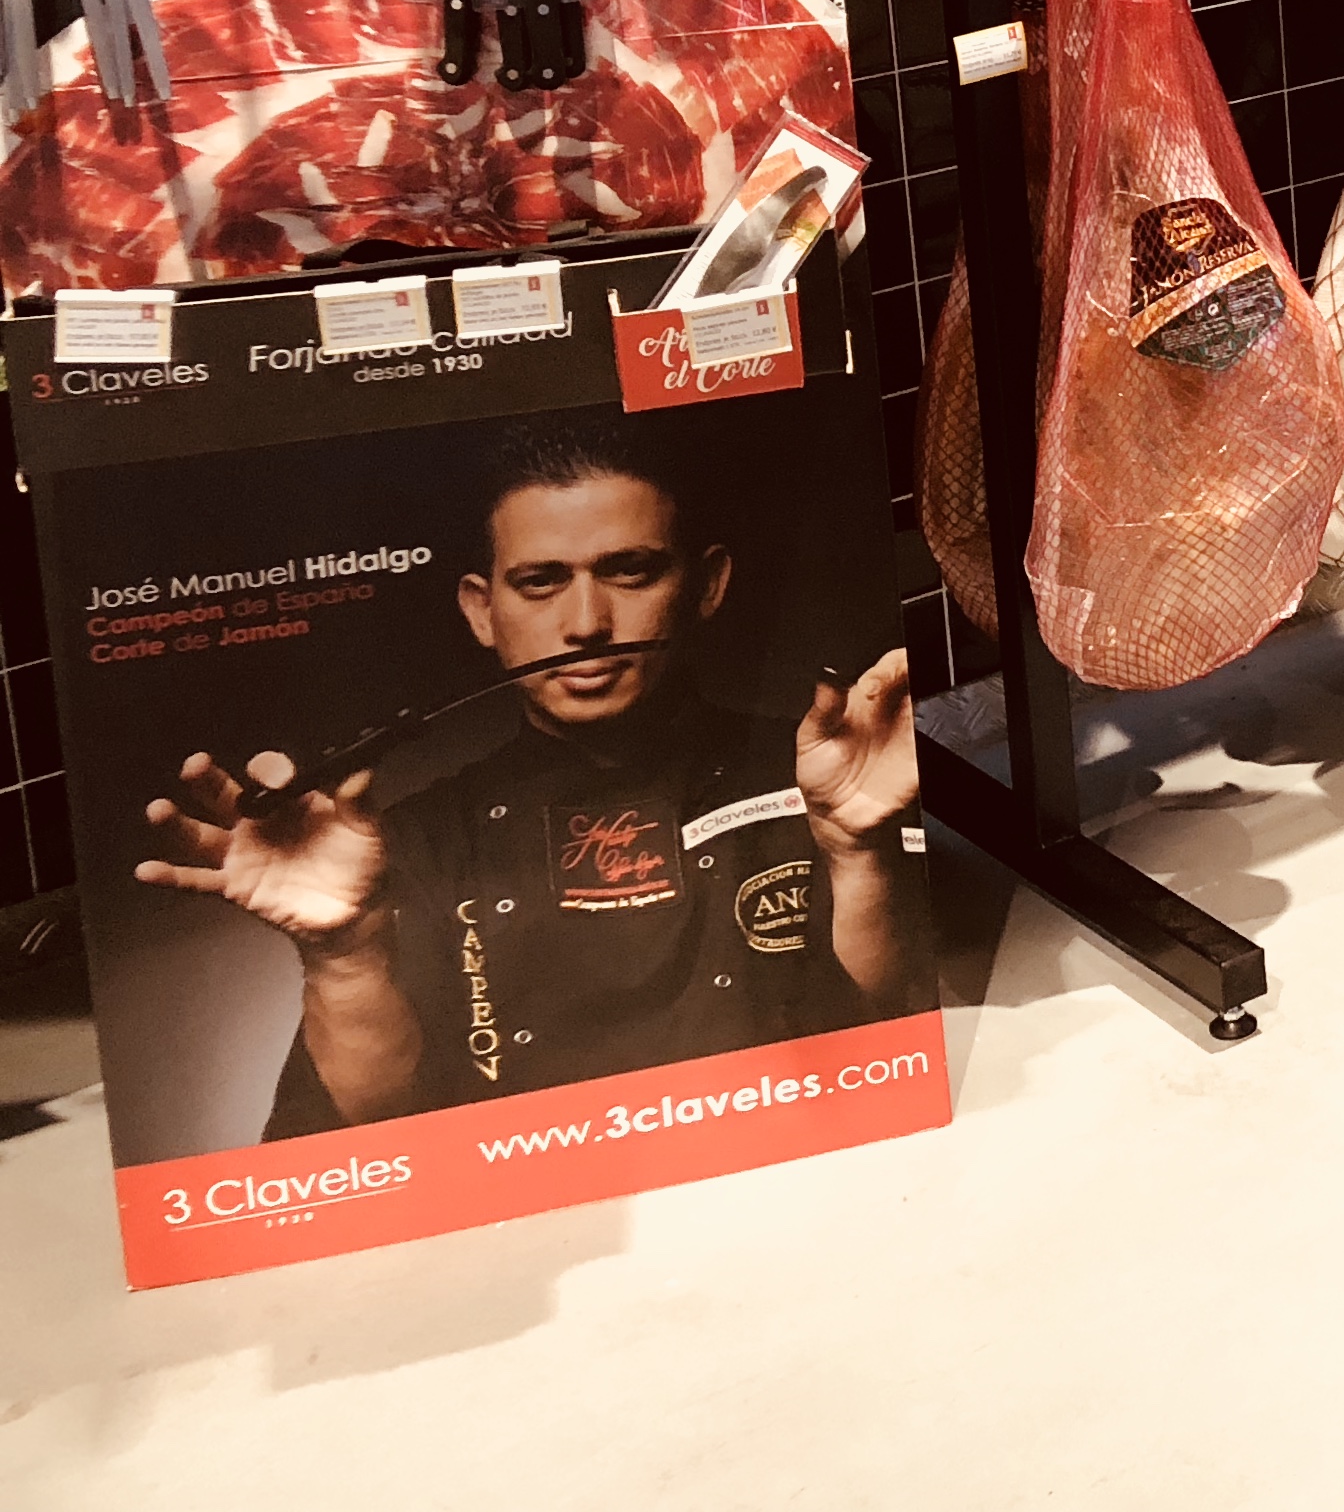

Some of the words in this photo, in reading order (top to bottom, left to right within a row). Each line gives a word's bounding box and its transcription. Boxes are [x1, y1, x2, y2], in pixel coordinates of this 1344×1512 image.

[33, 373, 54, 399] 3
[61, 361, 210, 395] Claveles
[352, 363, 425, 383] desde
[431, 353, 484, 376] 1930
[663, 359, 691, 390] el
[696, 354, 776, 393] Corte
[85, 577, 160, 611] José
[170, 559, 297, 600] Manuel
[304, 545, 432, 580] Hidalgo
[86, 600, 226, 636] Campeón
[232, 595, 269, 618] de
[90, 639, 166, 664] Corte
[173, 632, 210, 652] de
[219, 616, 310, 646] Jamón
[700, 799, 781, 833] Claveles
[477, 1050, 930, 1164] www.3claveles.com
[163, 1189, 192, 1225] 3
[205, 1155, 413, 1217] Claveles
